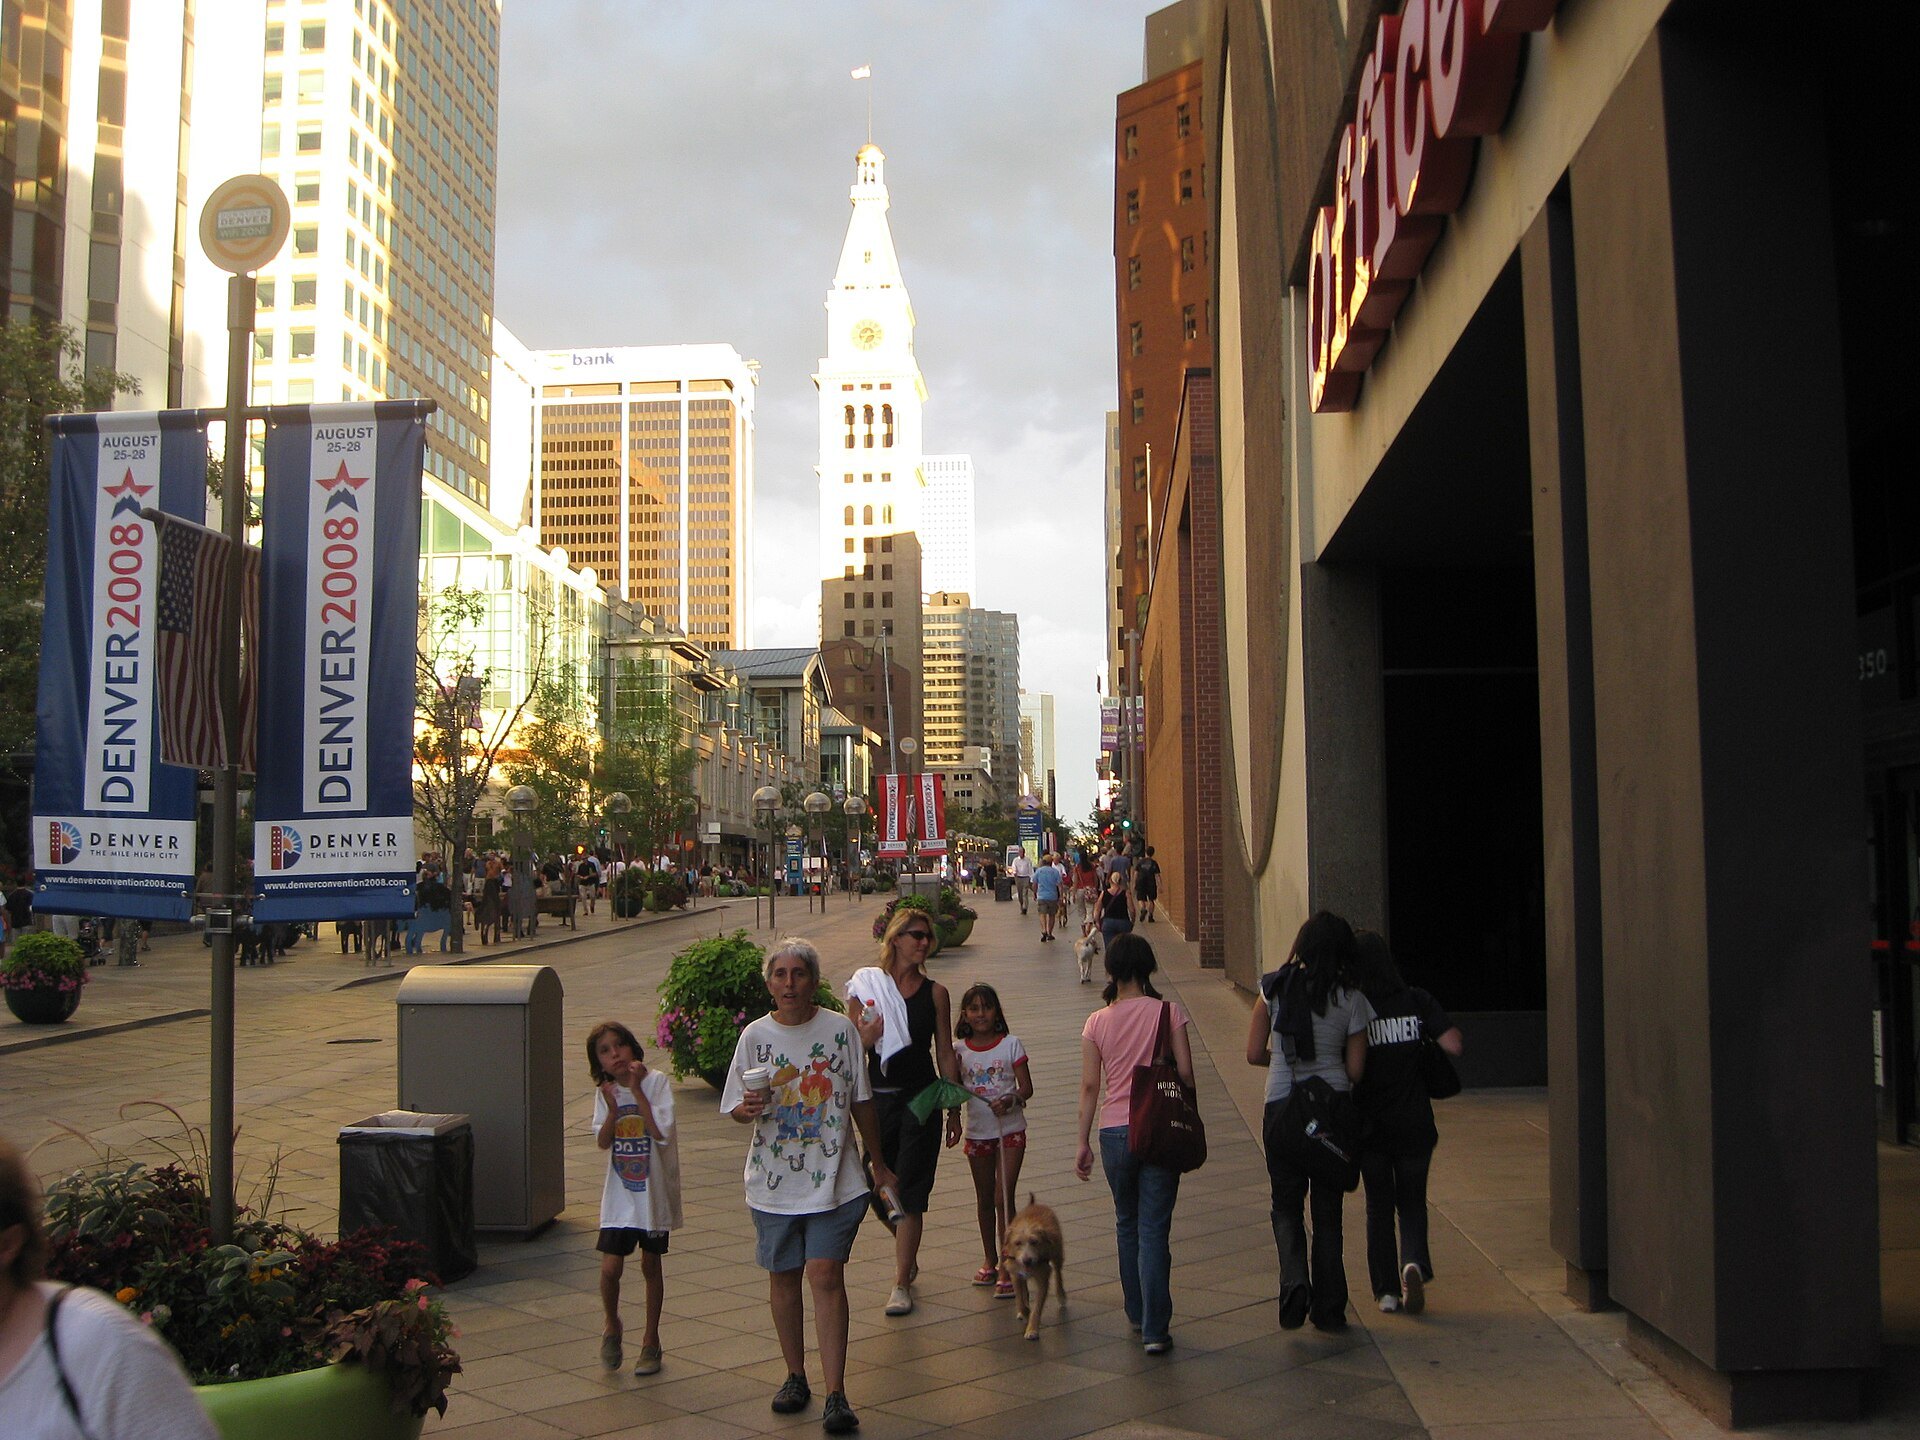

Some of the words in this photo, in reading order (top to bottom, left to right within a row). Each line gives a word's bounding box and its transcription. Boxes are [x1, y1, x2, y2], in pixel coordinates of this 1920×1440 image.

[573, 352, 614, 365] bank
[315, 427, 373, 440] AUGUST
[103, 435, 158, 448] AUGUST
[327, 441, 361, 453] 25-28
[113, 449, 146, 461] 25-28
[90, 832, 179, 849] DENVER
[310, 832, 397, 849] DENVER
[159, 852, 179, 860] CITY
[310, 851, 326, 859] THE
[353, 850, 374, 858] HIGH
[44, 875, 186, 890] www.denverconvention2008.com
[263, 878, 408, 891] www.denverconvention2008.com
